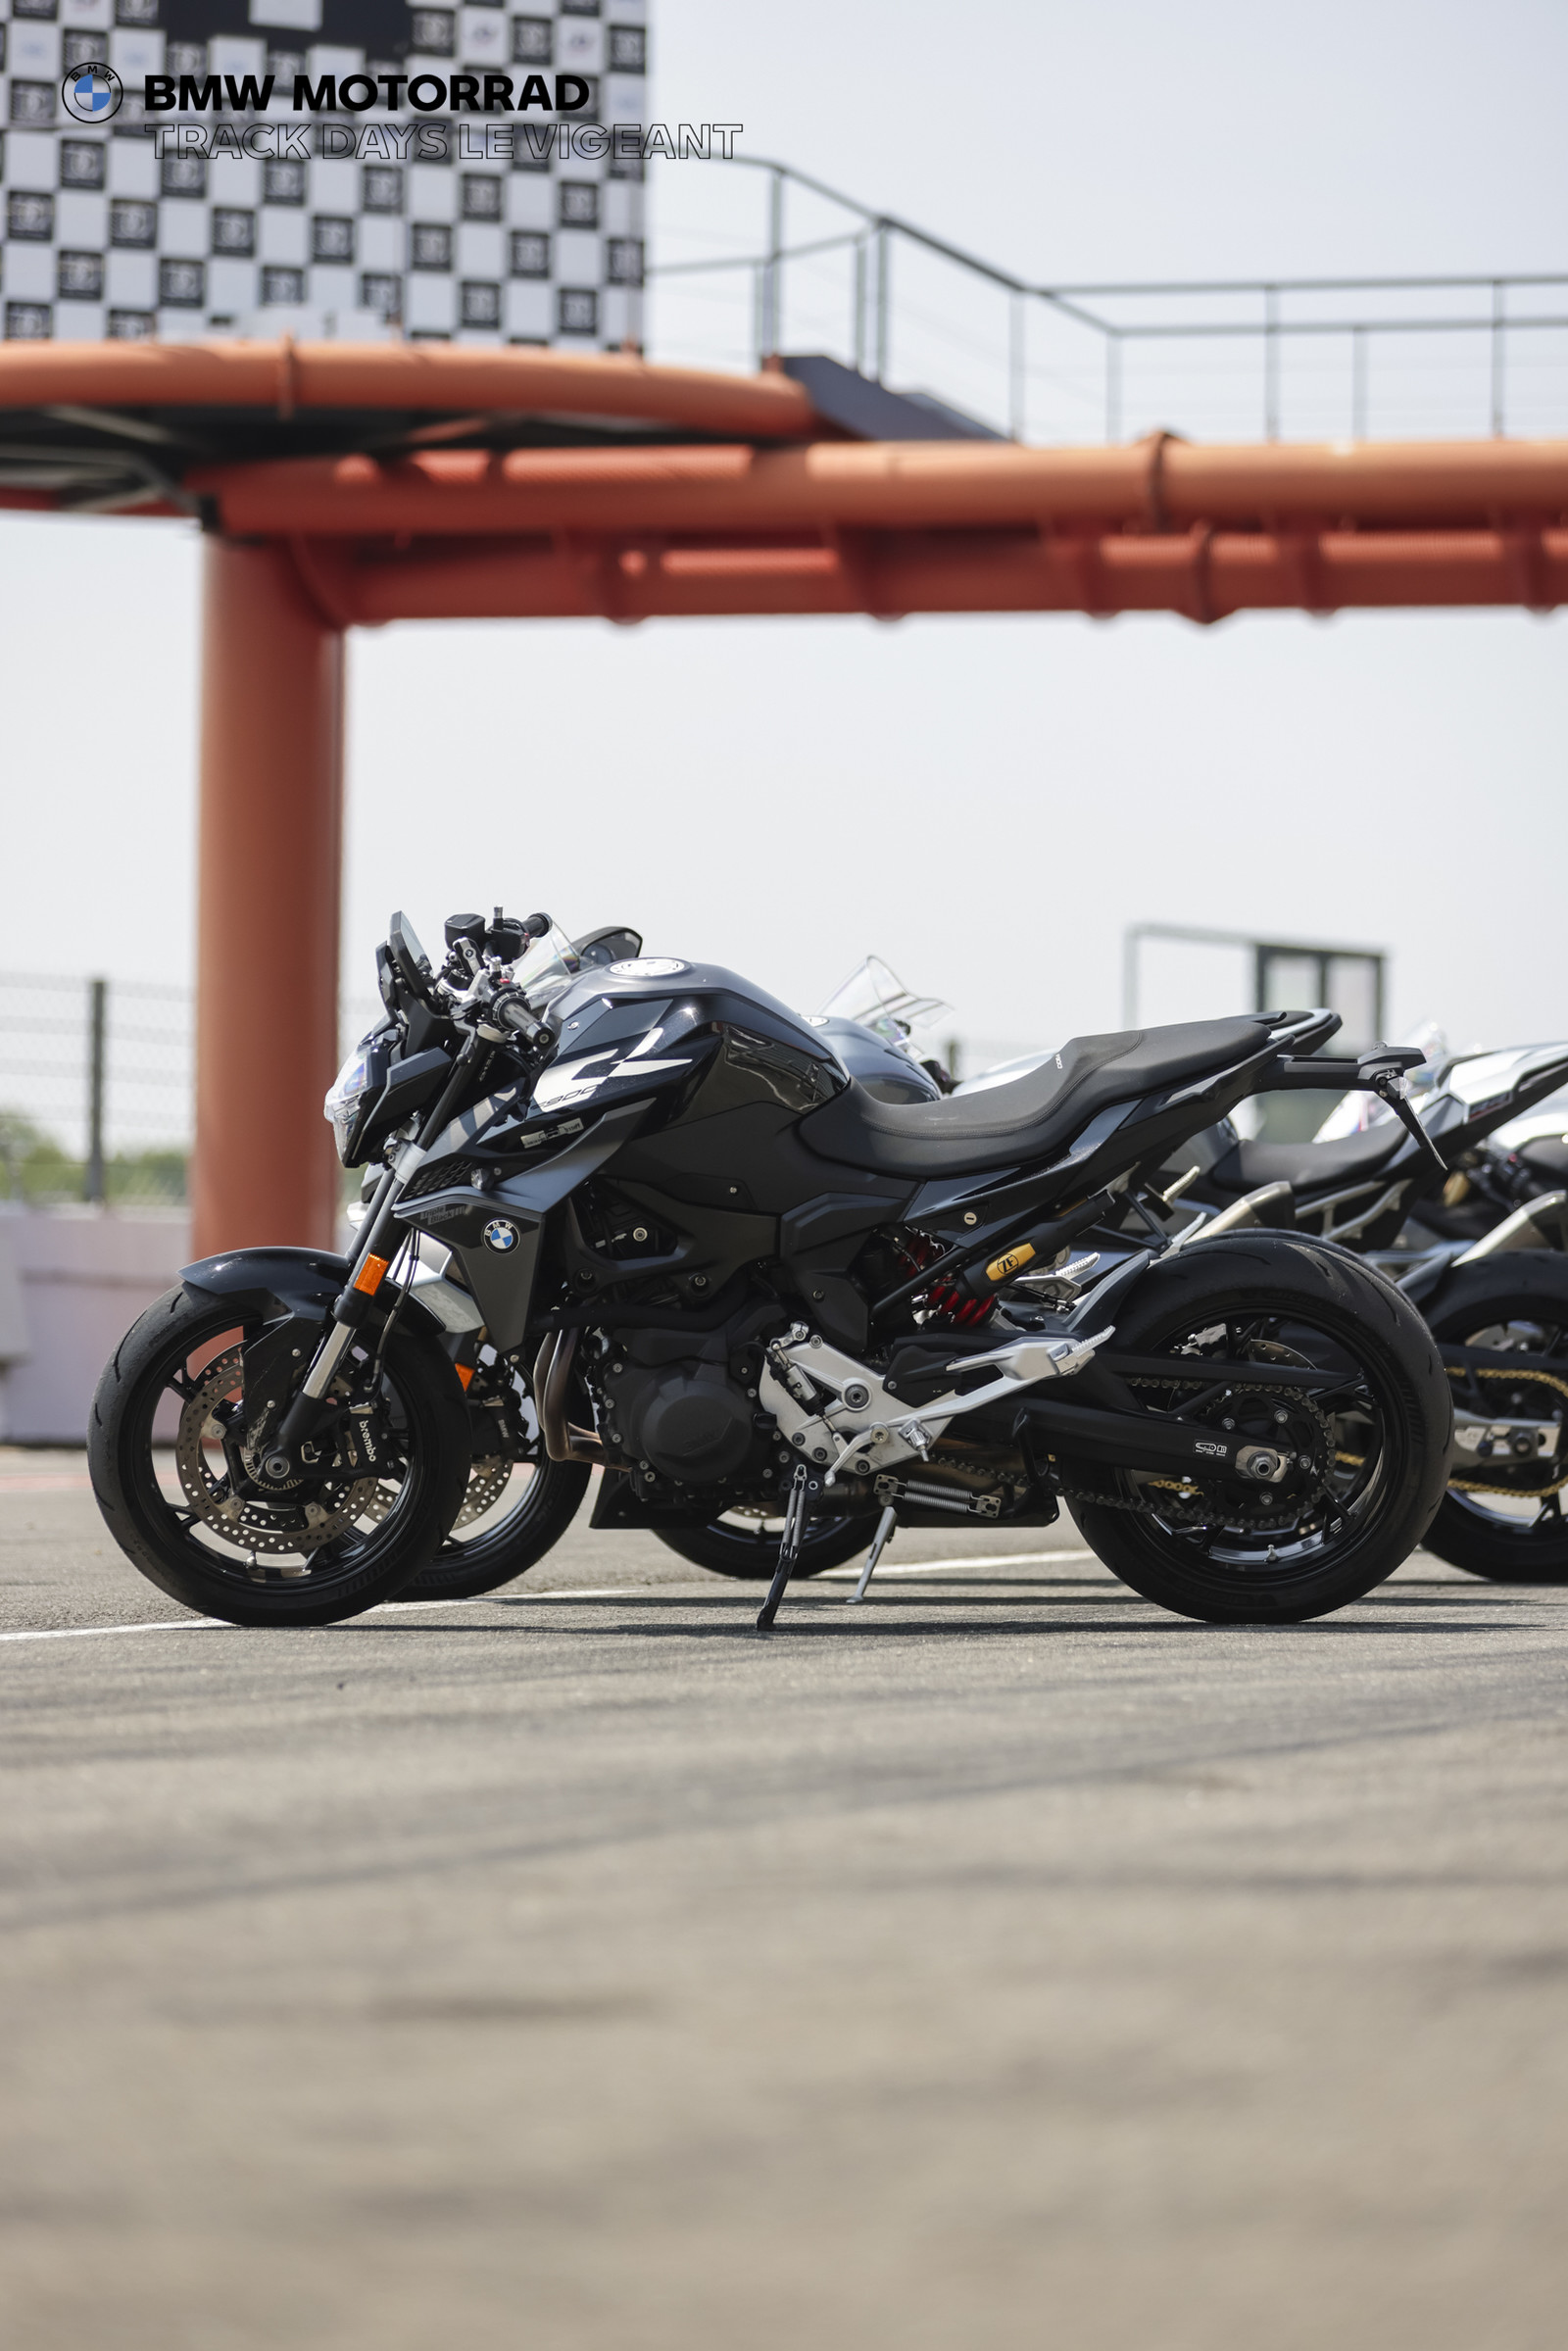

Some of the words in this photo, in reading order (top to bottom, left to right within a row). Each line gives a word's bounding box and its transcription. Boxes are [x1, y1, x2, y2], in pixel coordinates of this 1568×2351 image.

[484, 1221, 514, 1237] BMW
[997, 1253, 1019, 1273] ZF
[497, 1418, 510, 1439] BMW
[359, 1419, 377, 1462] brembo
